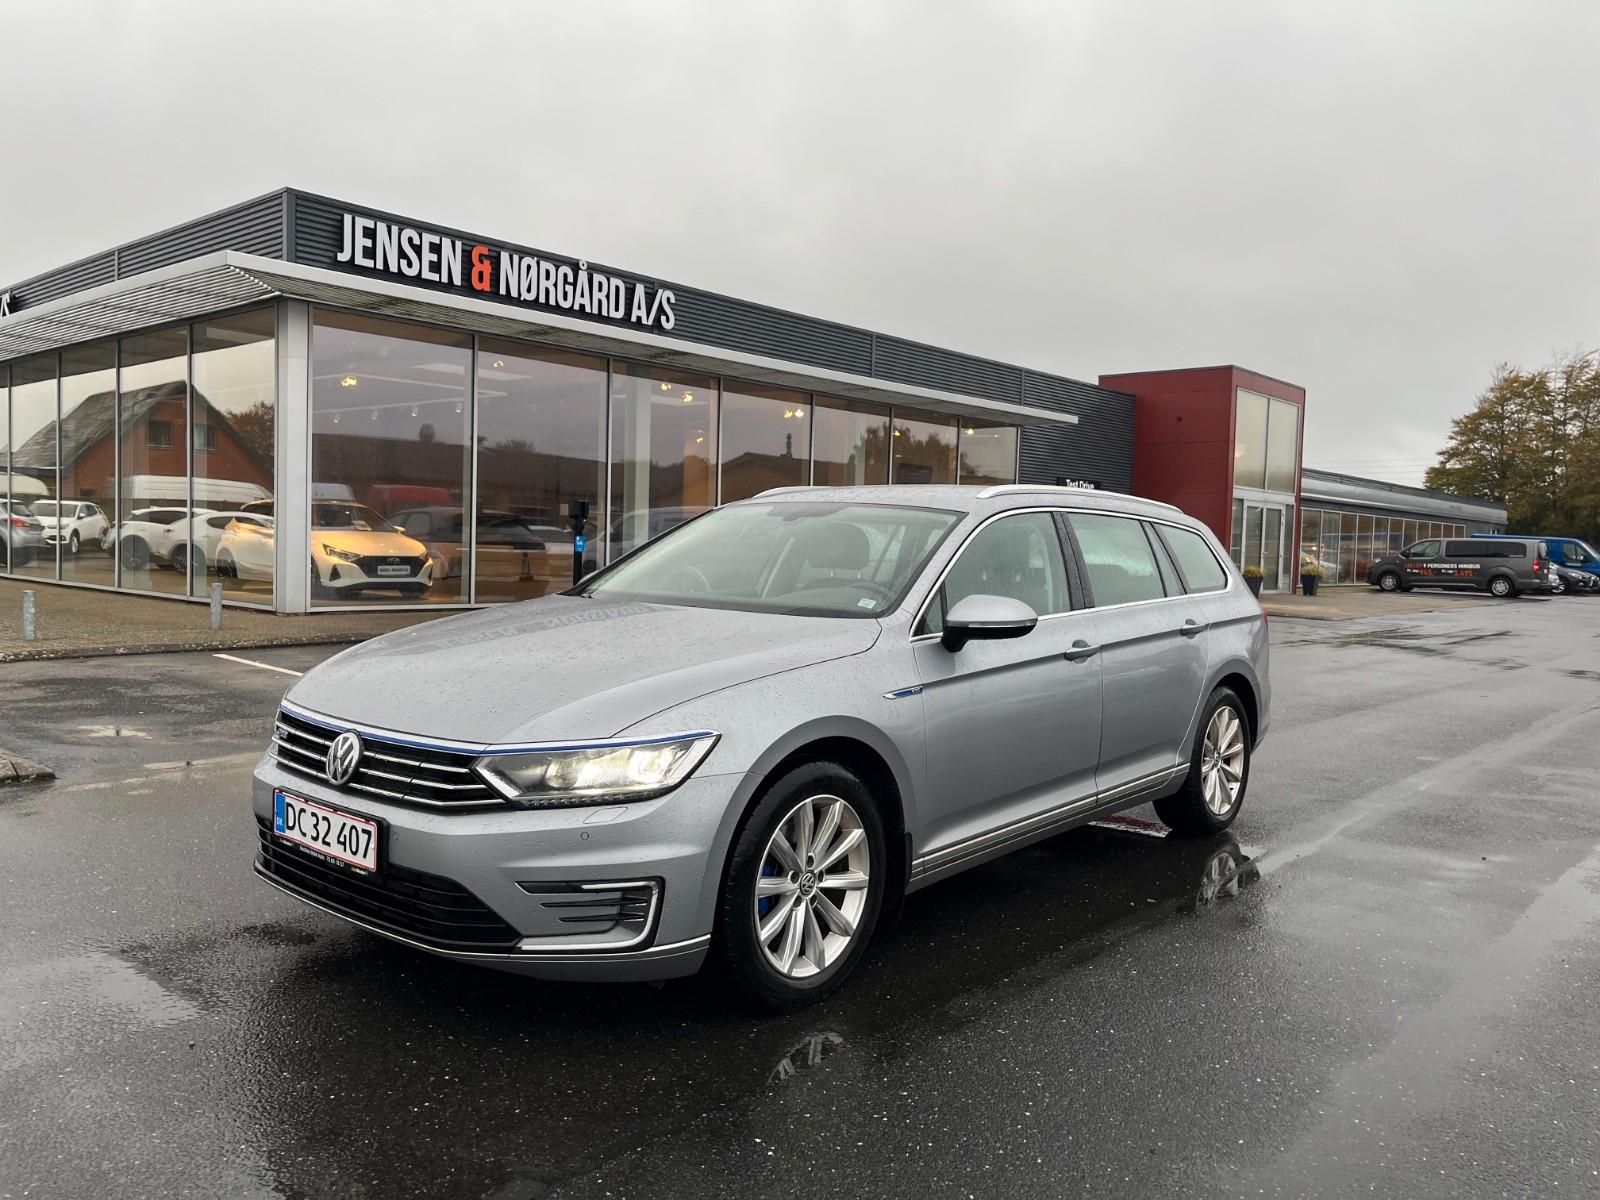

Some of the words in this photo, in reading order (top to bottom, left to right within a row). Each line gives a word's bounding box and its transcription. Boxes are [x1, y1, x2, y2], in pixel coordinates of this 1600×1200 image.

[337, 213, 462, 286] JENSEN
[471, 245, 492, 292] &
[500, 251, 626, 320] NØRGÅRD
[631, 283, 676, 330] A/S
[286, 801, 306, 838] DC
[310, 811, 331, 847] 32
[336, 822, 372, 859] 407
